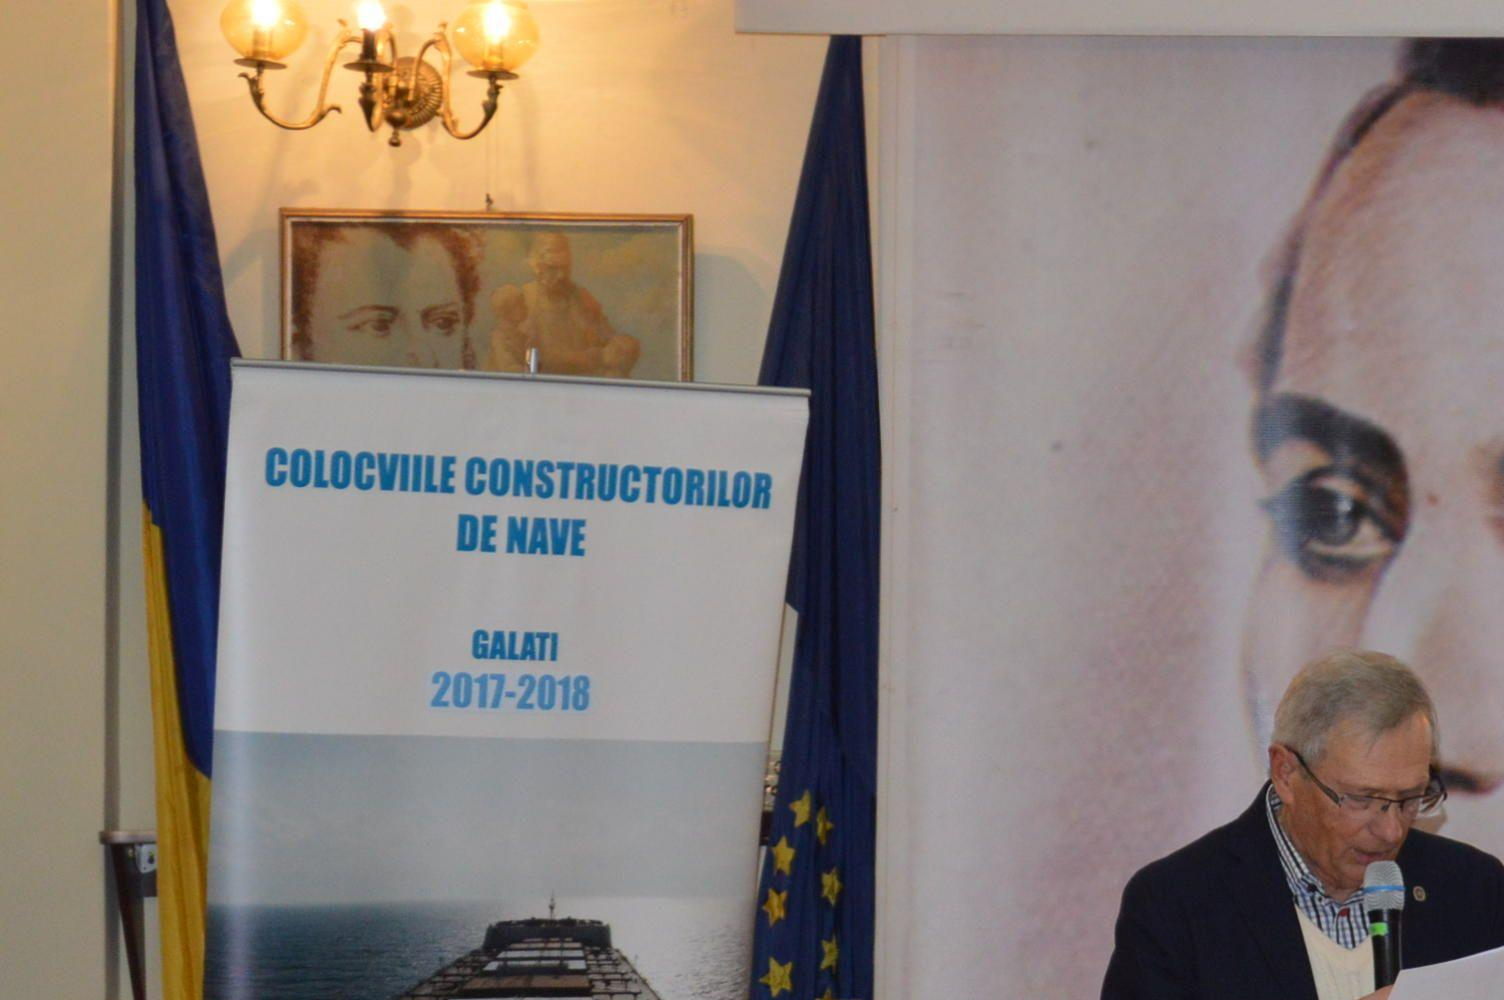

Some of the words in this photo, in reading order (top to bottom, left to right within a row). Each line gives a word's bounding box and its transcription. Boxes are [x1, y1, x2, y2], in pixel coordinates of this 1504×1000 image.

[264, 446, 457, 495] COLOCVIILE
[464, 457, 774, 510] CONSTRUCTORILOR
[455, 513, 498, 553] DE
[504, 517, 588, 557] NAVE
[471, 629, 559, 662] GALATI
[429, 670, 592, 712] 2017-2018
